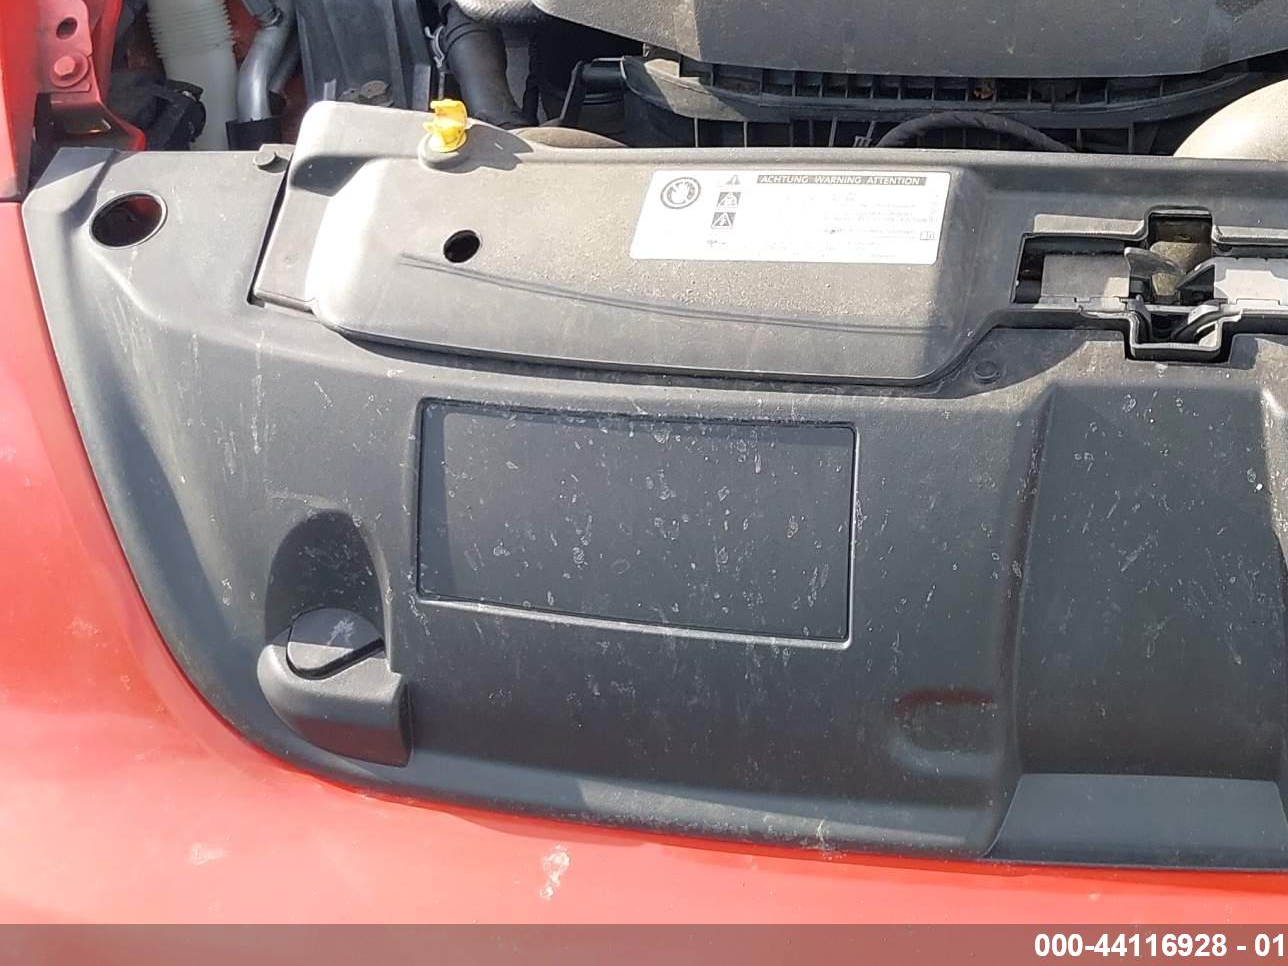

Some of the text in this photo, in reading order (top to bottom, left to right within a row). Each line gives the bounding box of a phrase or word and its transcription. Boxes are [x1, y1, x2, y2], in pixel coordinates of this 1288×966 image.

[760, 174, 921, 186] ACHTUNG WARNING ATTENTION
